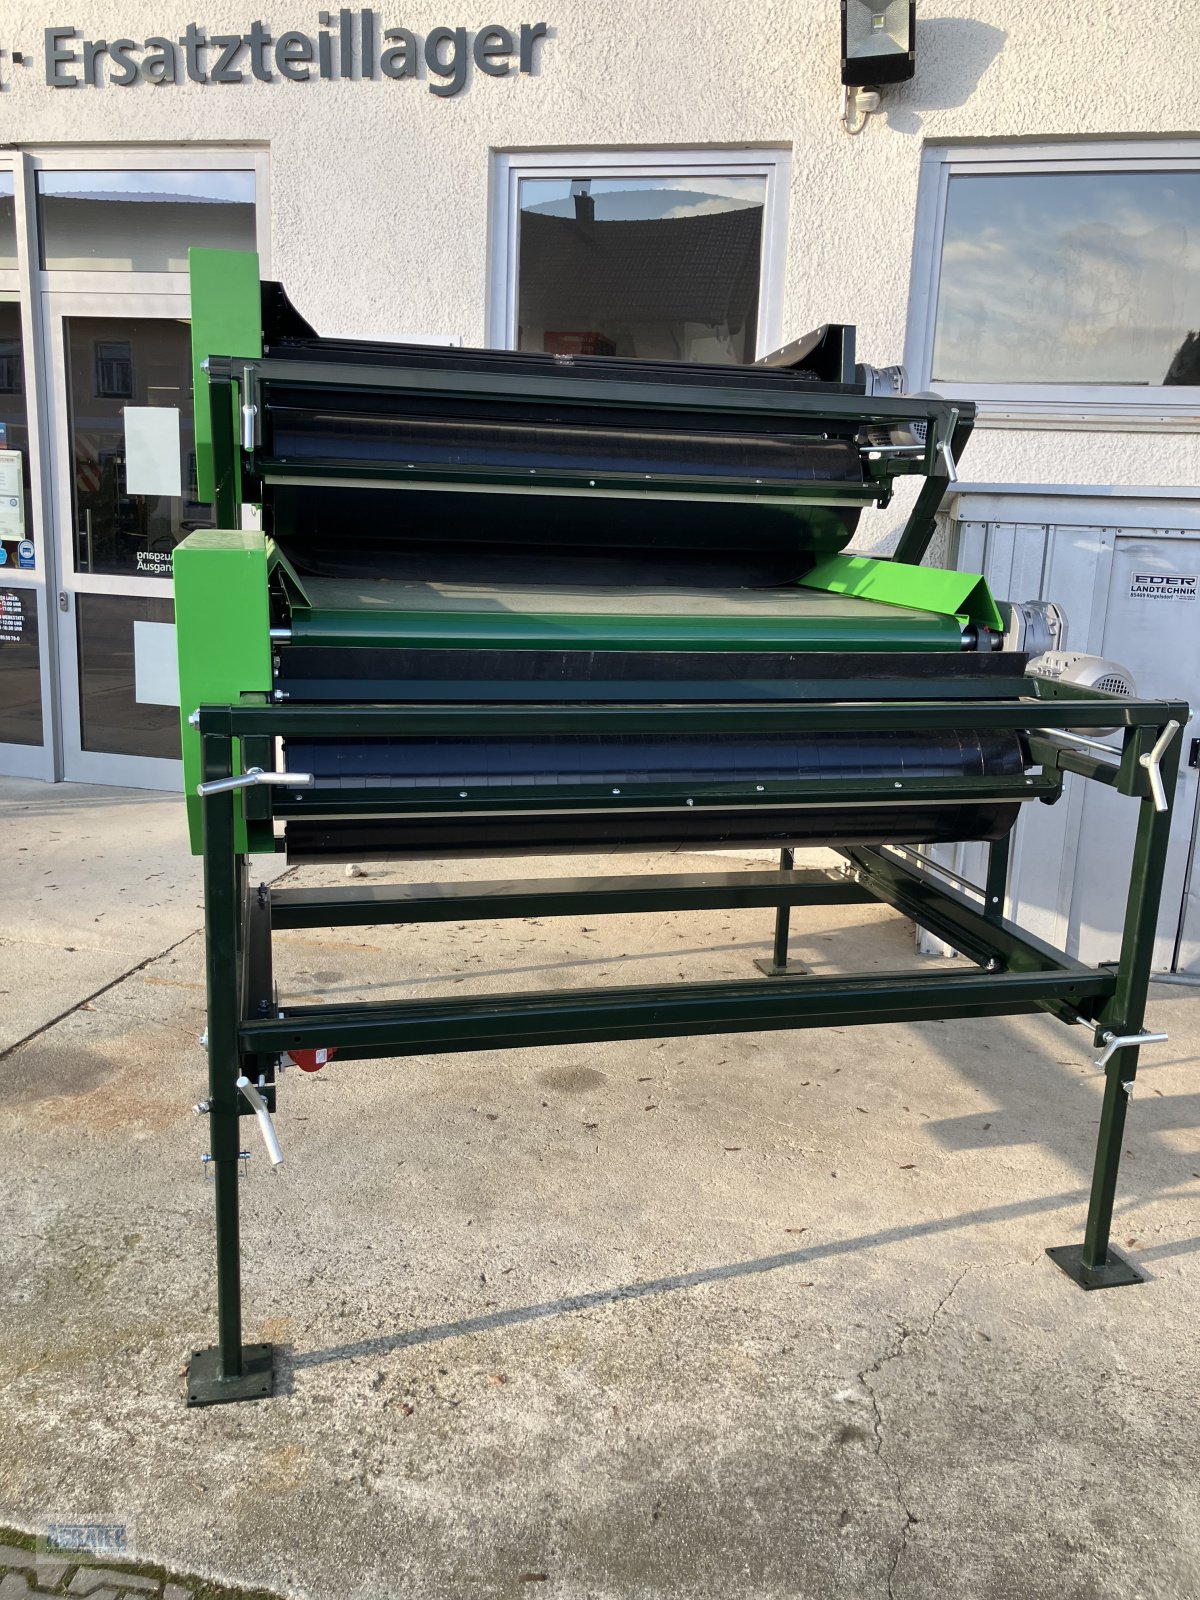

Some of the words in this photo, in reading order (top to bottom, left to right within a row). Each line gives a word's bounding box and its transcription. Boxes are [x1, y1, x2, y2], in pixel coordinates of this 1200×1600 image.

[44, 8, 548, 96] Ersatzteillager
[136, 561, 173, 573] Ausgan
[1135, 575, 1195, 585] EDER
[1130, 585, 1197, 595] LANDTECHNIK
